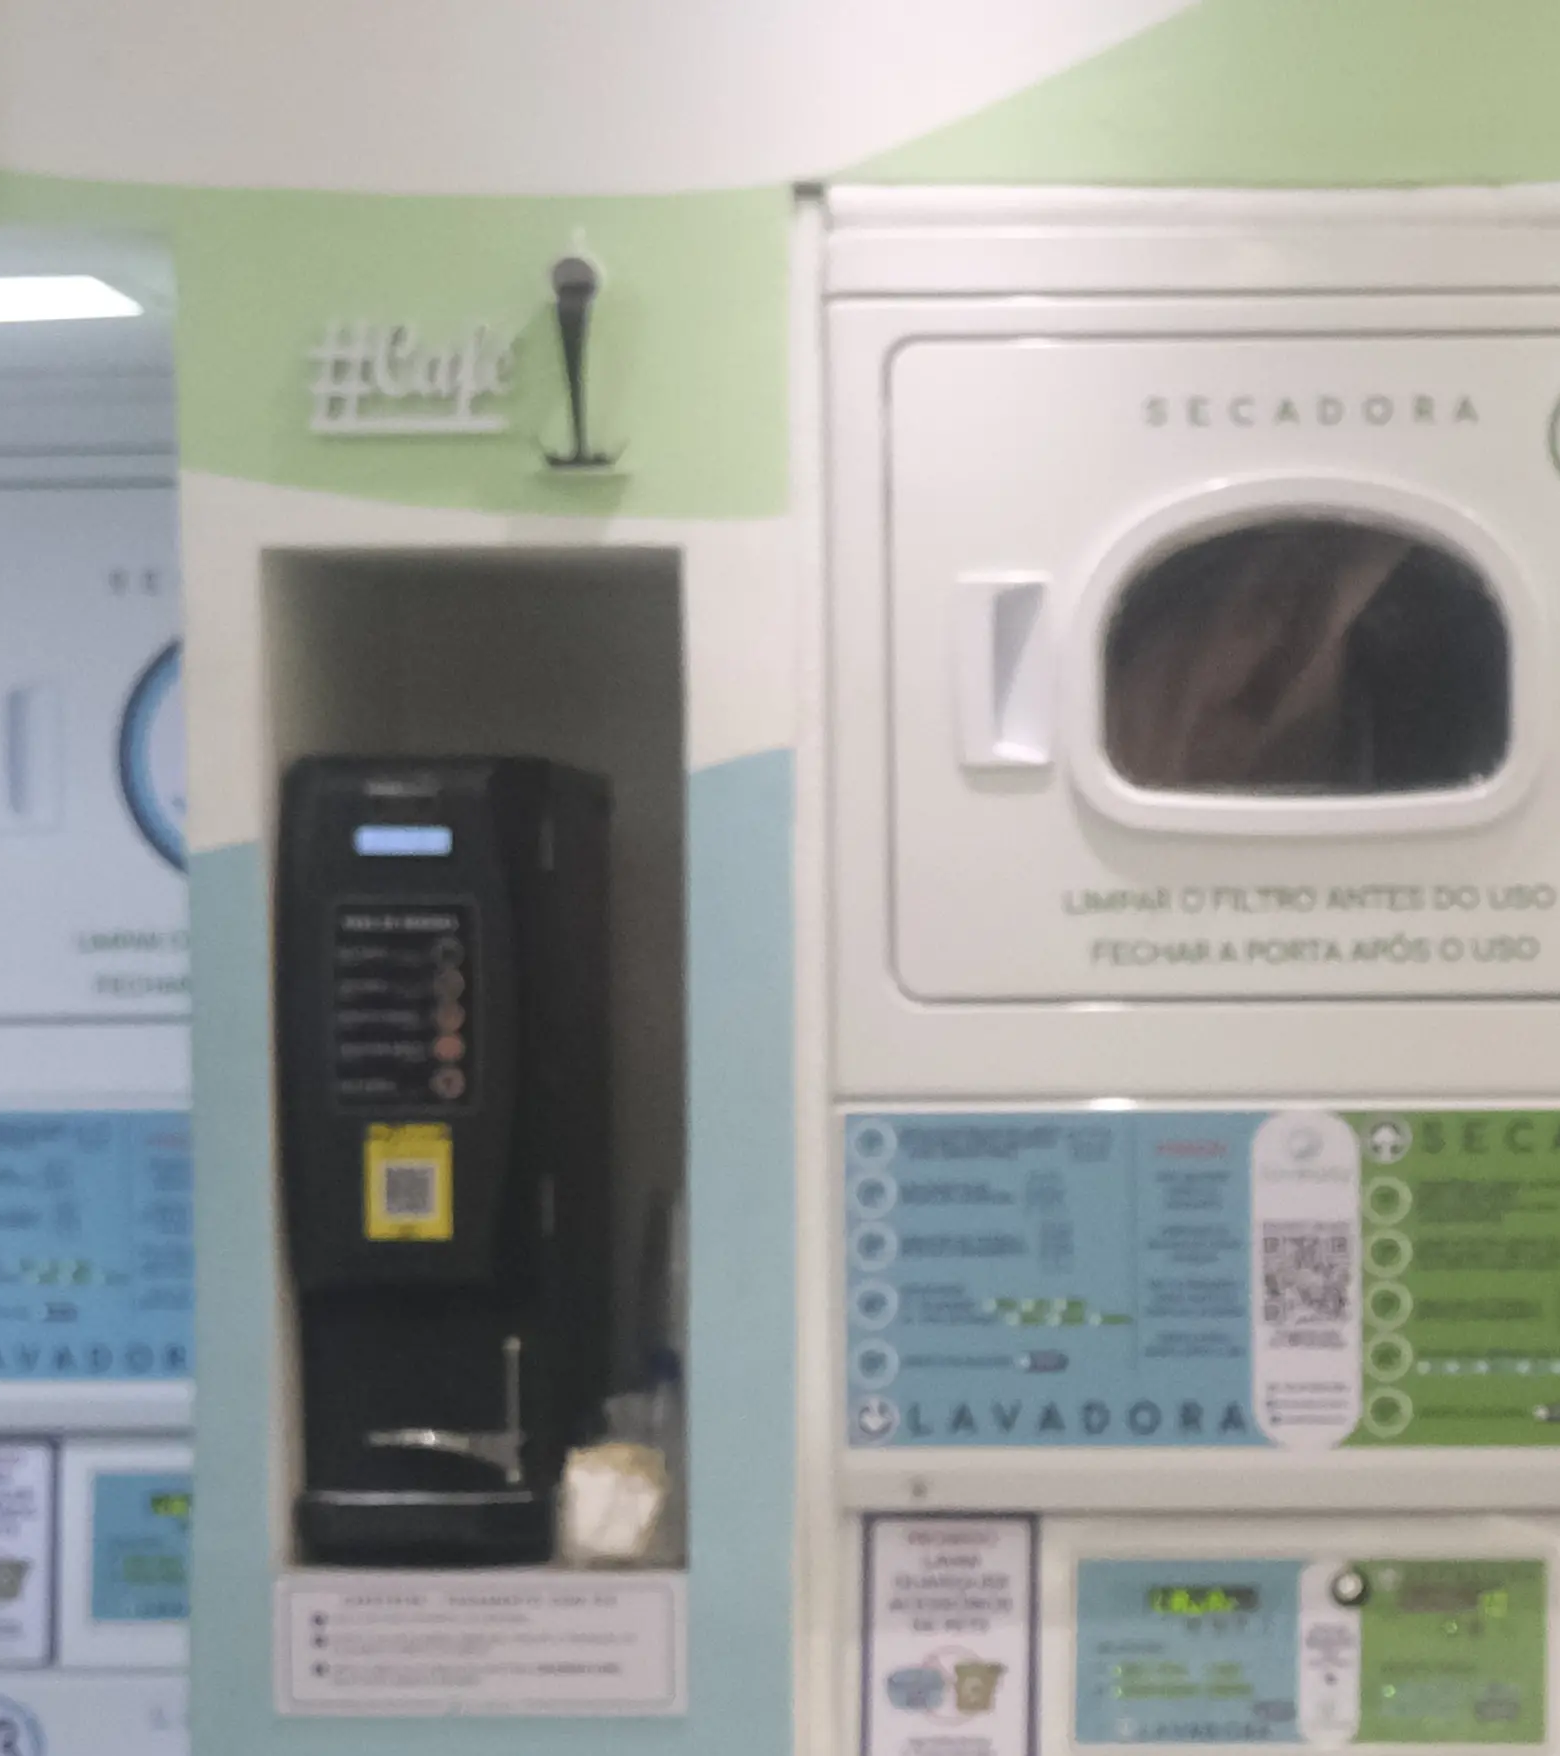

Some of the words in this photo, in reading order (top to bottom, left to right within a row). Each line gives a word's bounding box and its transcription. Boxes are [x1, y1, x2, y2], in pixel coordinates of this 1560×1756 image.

[1145, 393, 1481, 427] SECADORA
[1062, 886, 1174, 919] LIMPAR
[1180, 887, 1204, 916] O
[1212, 883, 1317, 914] FILTRO
[1326, 882, 1424, 913] ANTES
[1436, 882, 1481, 912] DO
[1488, 880, 1556, 911] USO
[1092, 938, 1211, 968] FECHAR
[1217, 936, 1241, 965] A
[1246, 934, 1345, 965] PORTA
[1350, 929, 1431, 964] APÓS
[1438, 932, 1465, 962] O
[1470, 931, 1541, 962] USO
[906, 1400, 1247, 1437] LAVADORA
